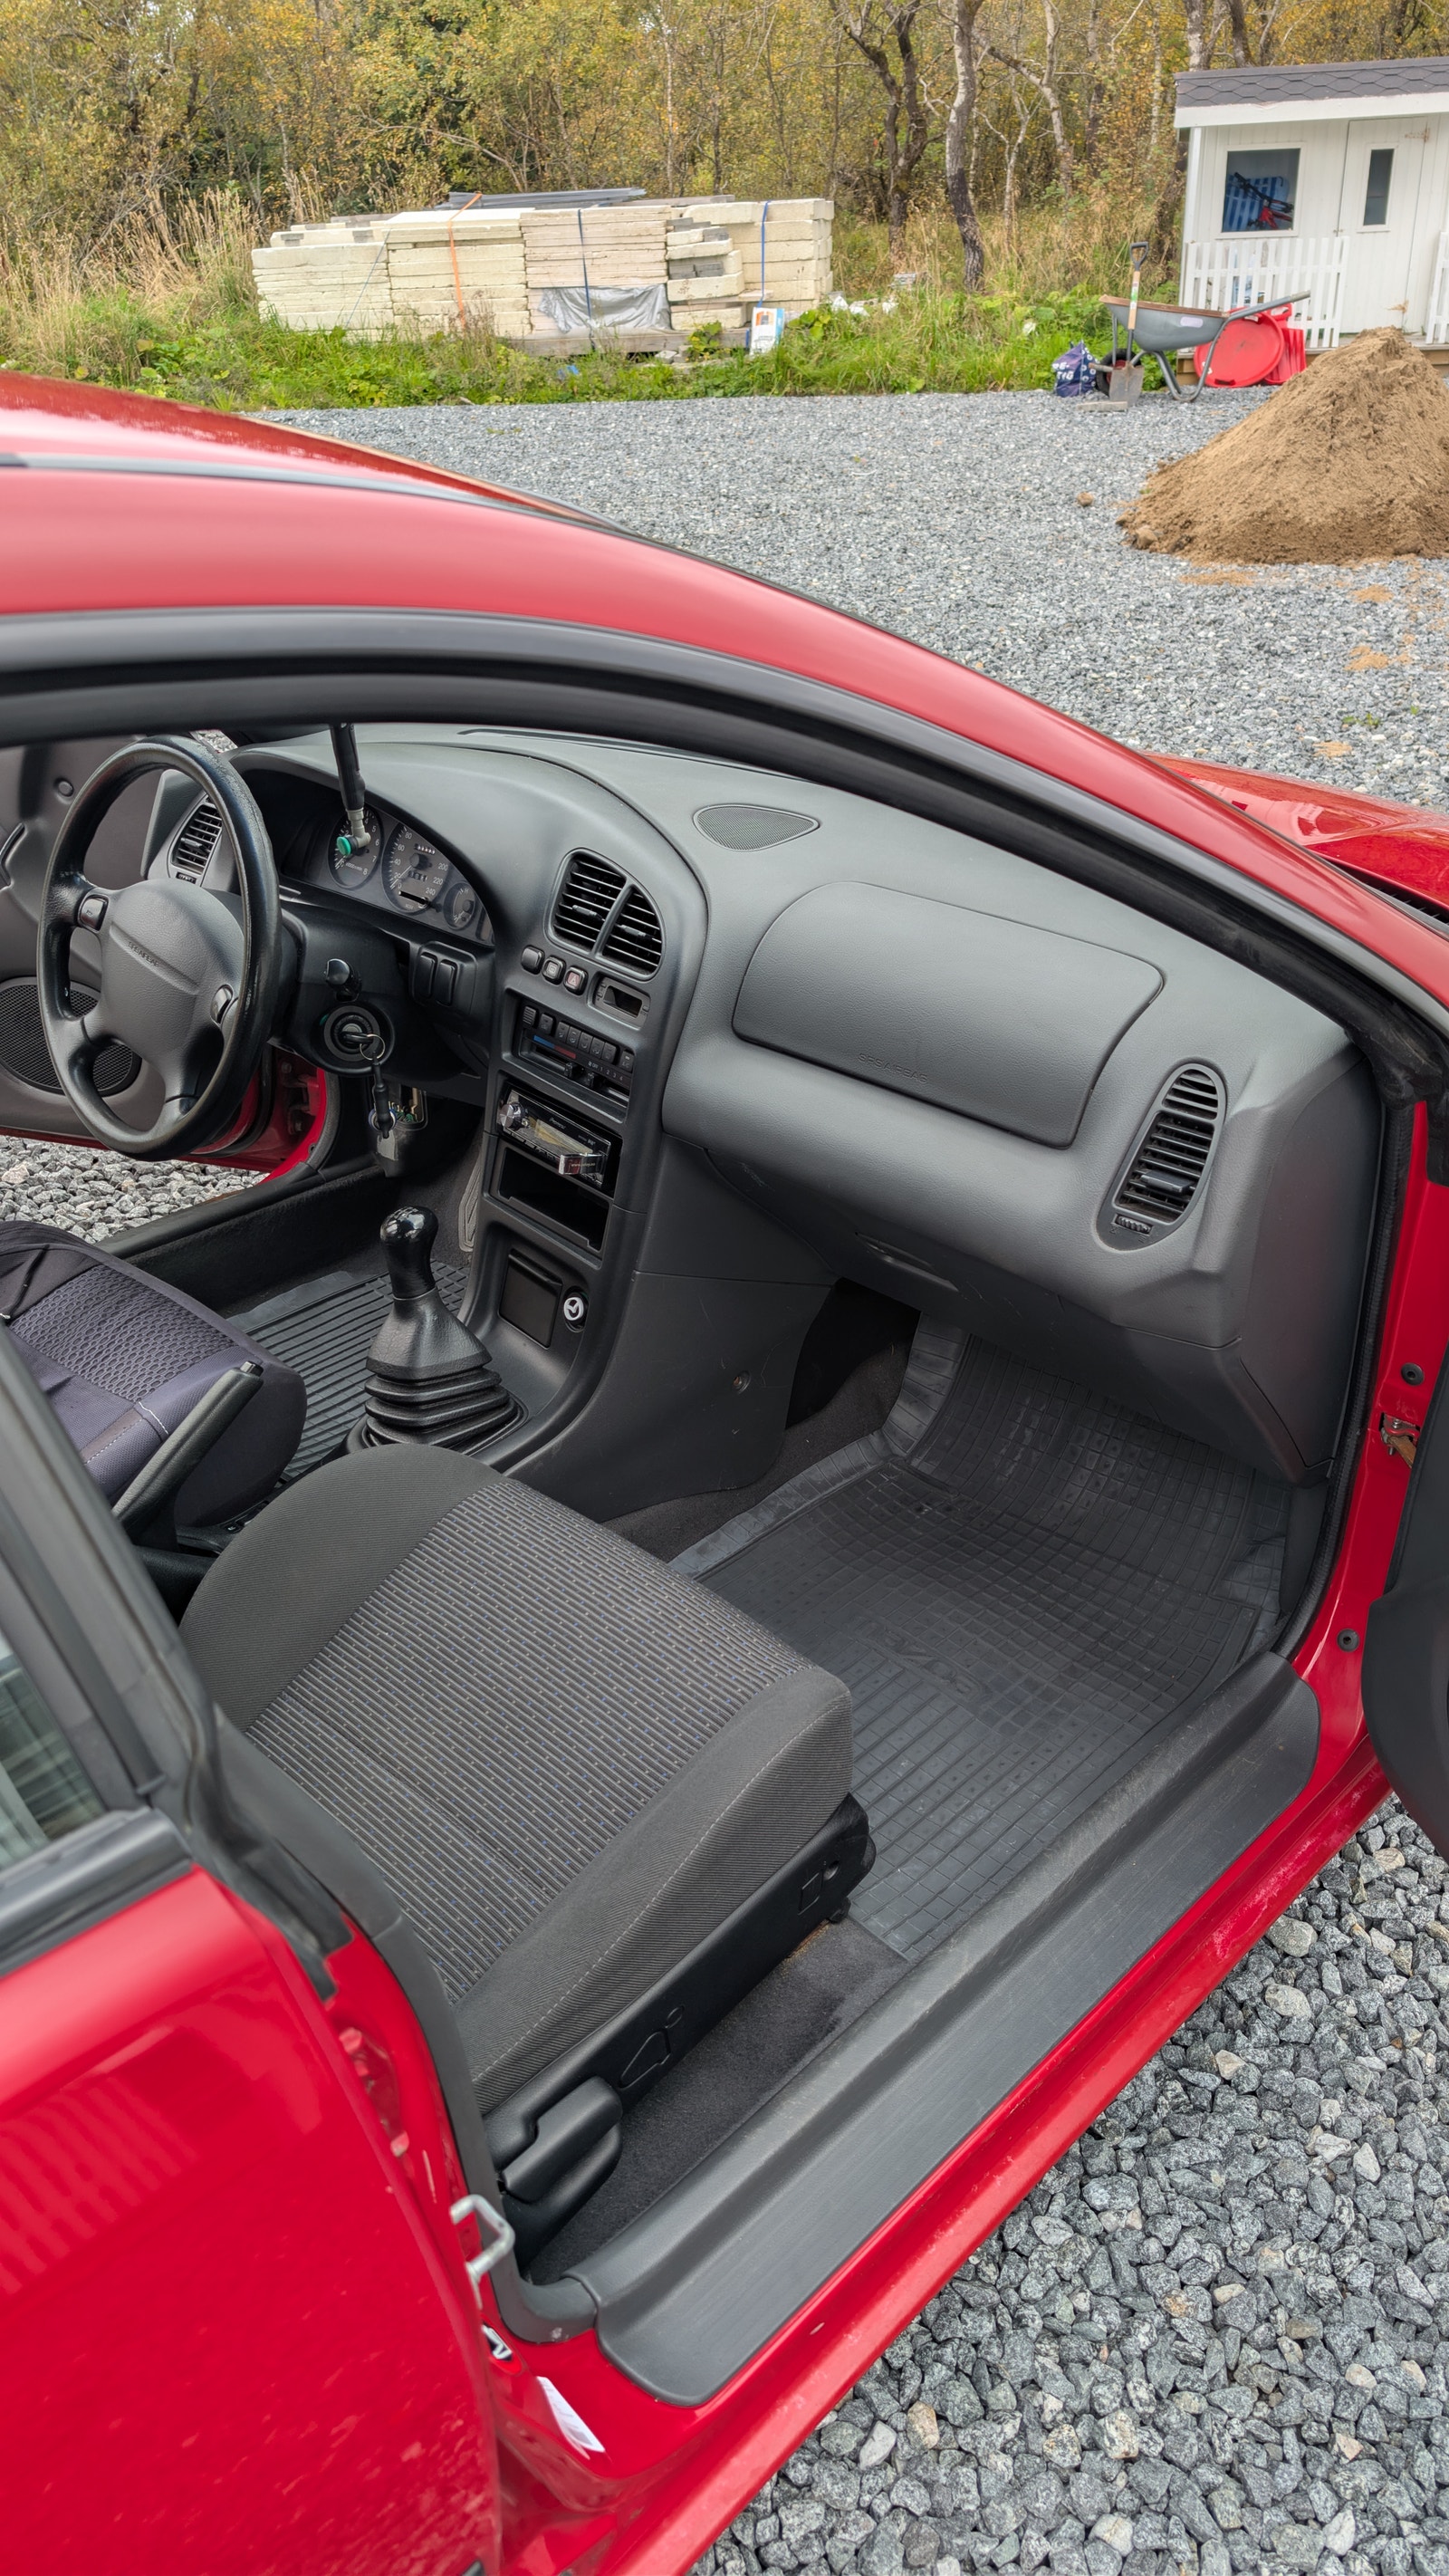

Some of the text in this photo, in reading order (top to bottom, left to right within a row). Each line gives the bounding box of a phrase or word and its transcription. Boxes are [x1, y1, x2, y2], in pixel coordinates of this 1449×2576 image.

[437, 862, 448, 871] 200
[433, 877, 444, 886] 220
[426, 888, 436, 896] 240
